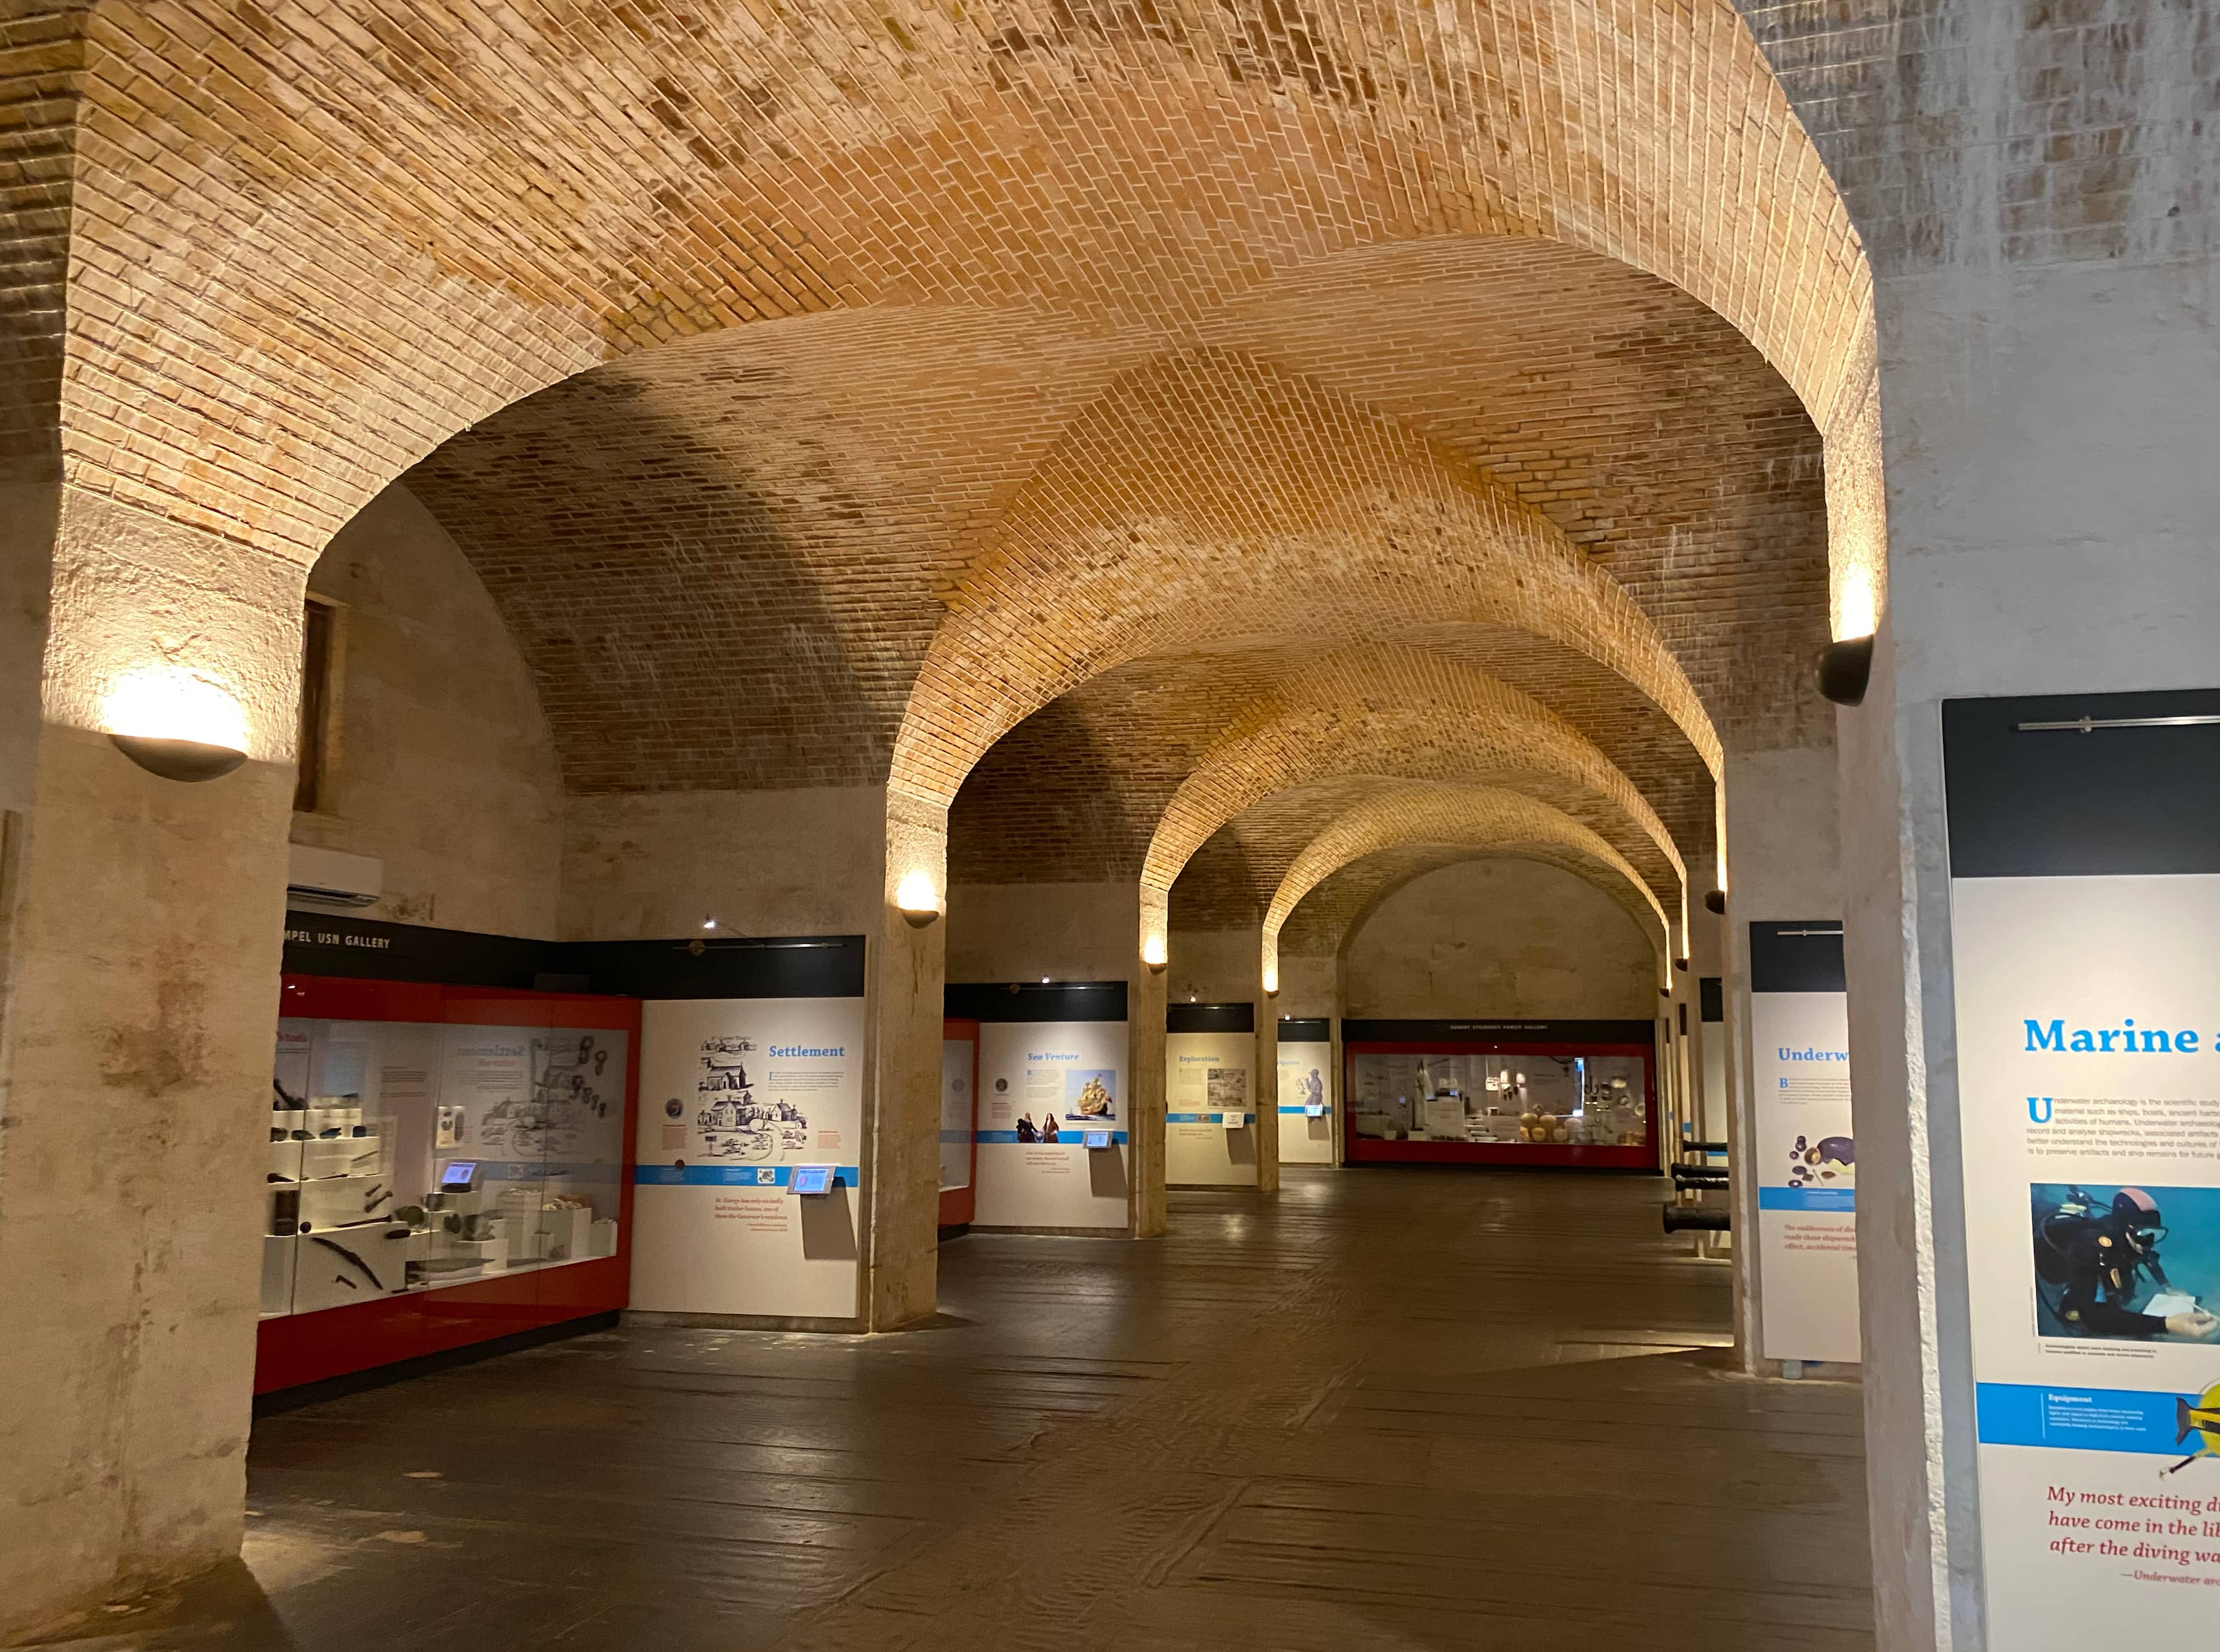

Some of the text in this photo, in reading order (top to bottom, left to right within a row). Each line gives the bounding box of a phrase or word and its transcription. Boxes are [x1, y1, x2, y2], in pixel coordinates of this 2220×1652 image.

[319, 932, 340, 944] USN
[345, 935, 391, 949] GALLERY
[2023, 1018, 2199, 1053] Marine
[769, 1045, 846, 1057] Settlement
[1027, 1053, 1079, 1061] Sea Venture
[1778, 1047, 1848, 1061] Underw
[2093, 1098, 2137, 1106] archaeology
[2048, 1394, 2092, 1403] Equipment
[2047, 1486, 2075, 1506] My
[2080, 1491, 2124, 1506] most
[2129, 1494, 2202, 1515] exciting
[2049, 1511, 2090, 1528] have
[2095, 1518, 2140, 1532] come
[2145, 1518, 2163, 1534] in
[2169, 1519, 2197, 1536] the
[2050, 1536, 2095, 1554] after
[2099, 1540, 2128, 1556] the
[2133, 1542, 2189, 1565] diving
